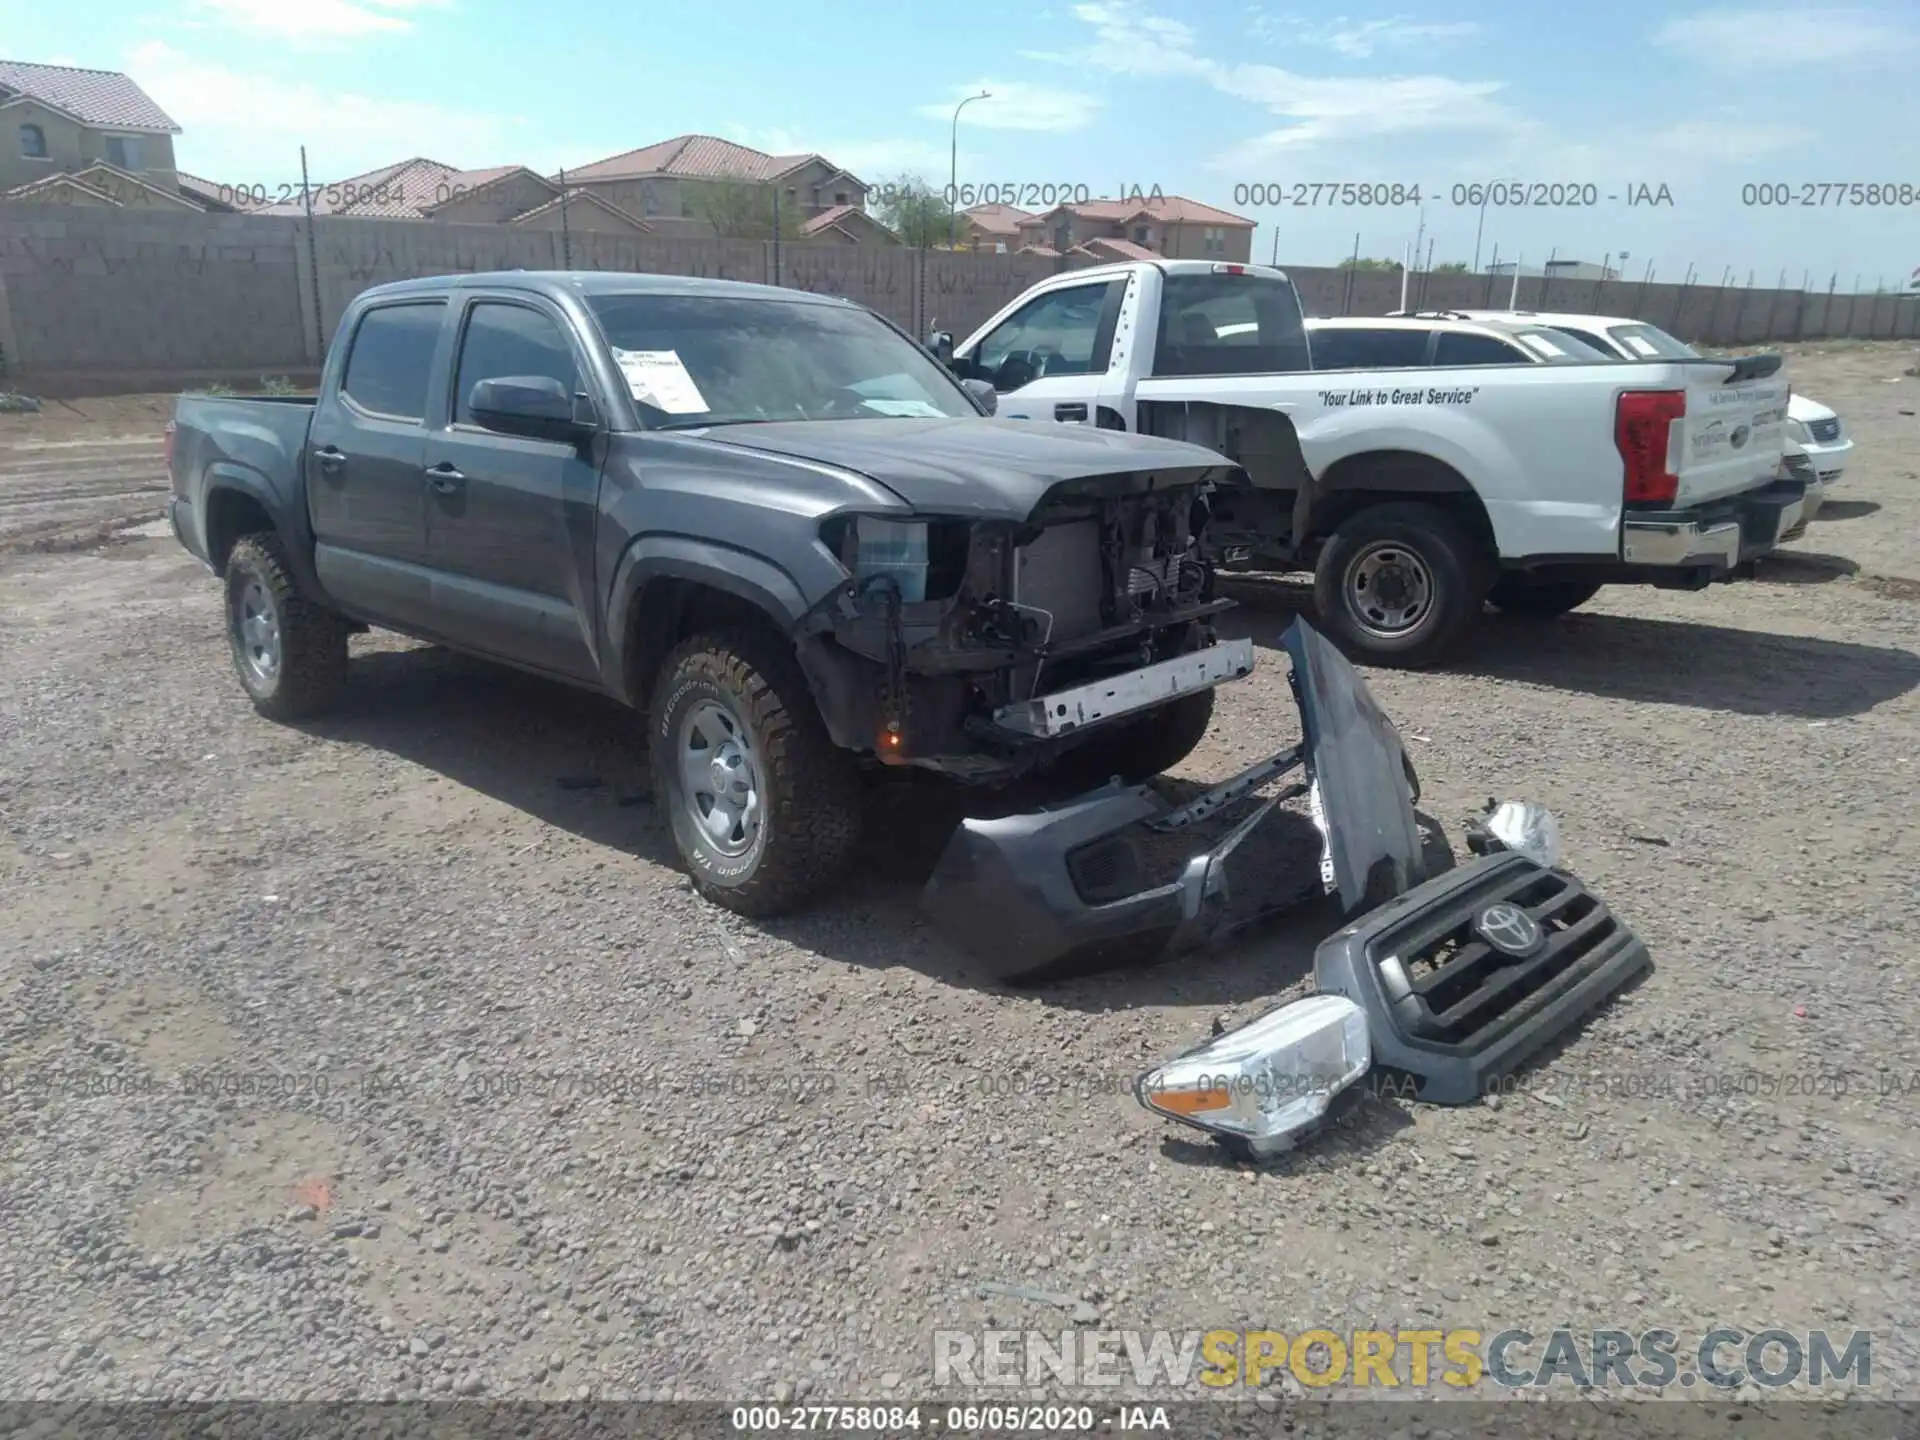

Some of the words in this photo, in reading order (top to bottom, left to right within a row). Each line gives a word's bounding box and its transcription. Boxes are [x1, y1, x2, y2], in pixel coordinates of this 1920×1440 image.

[1318, 390, 1347, 407] "Your
[1350, 389, 1373, 406] Link
[1376, 389, 1388, 406] to
[1392, 388, 1423, 405] Great
[1426, 386, 1480, 405] Service"
